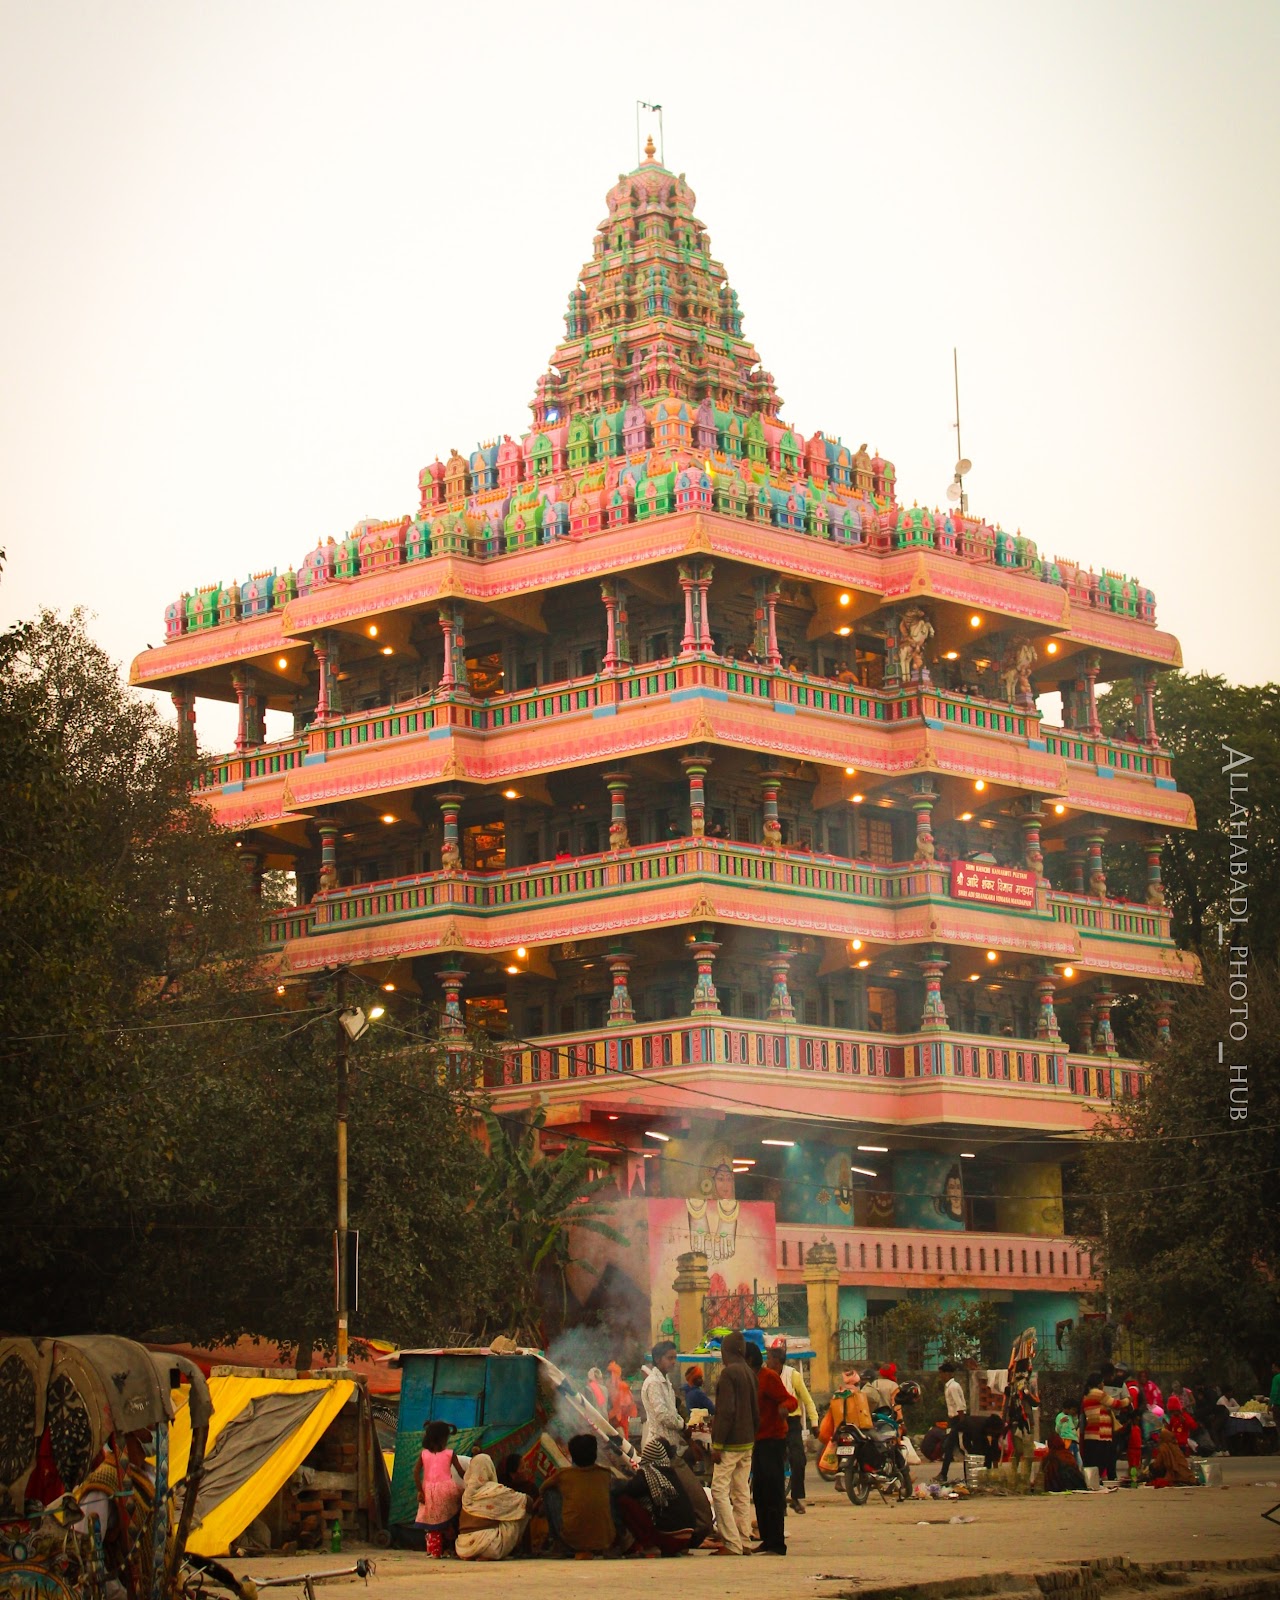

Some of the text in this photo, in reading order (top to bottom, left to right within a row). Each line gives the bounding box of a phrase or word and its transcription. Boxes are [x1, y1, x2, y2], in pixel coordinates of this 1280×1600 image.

[956, 872, 964, 886] श्री
[966, 873, 979, 888] आदि
[981, 876, 995, 891] शंकर
[997, 878, 1013, 894] विमान
